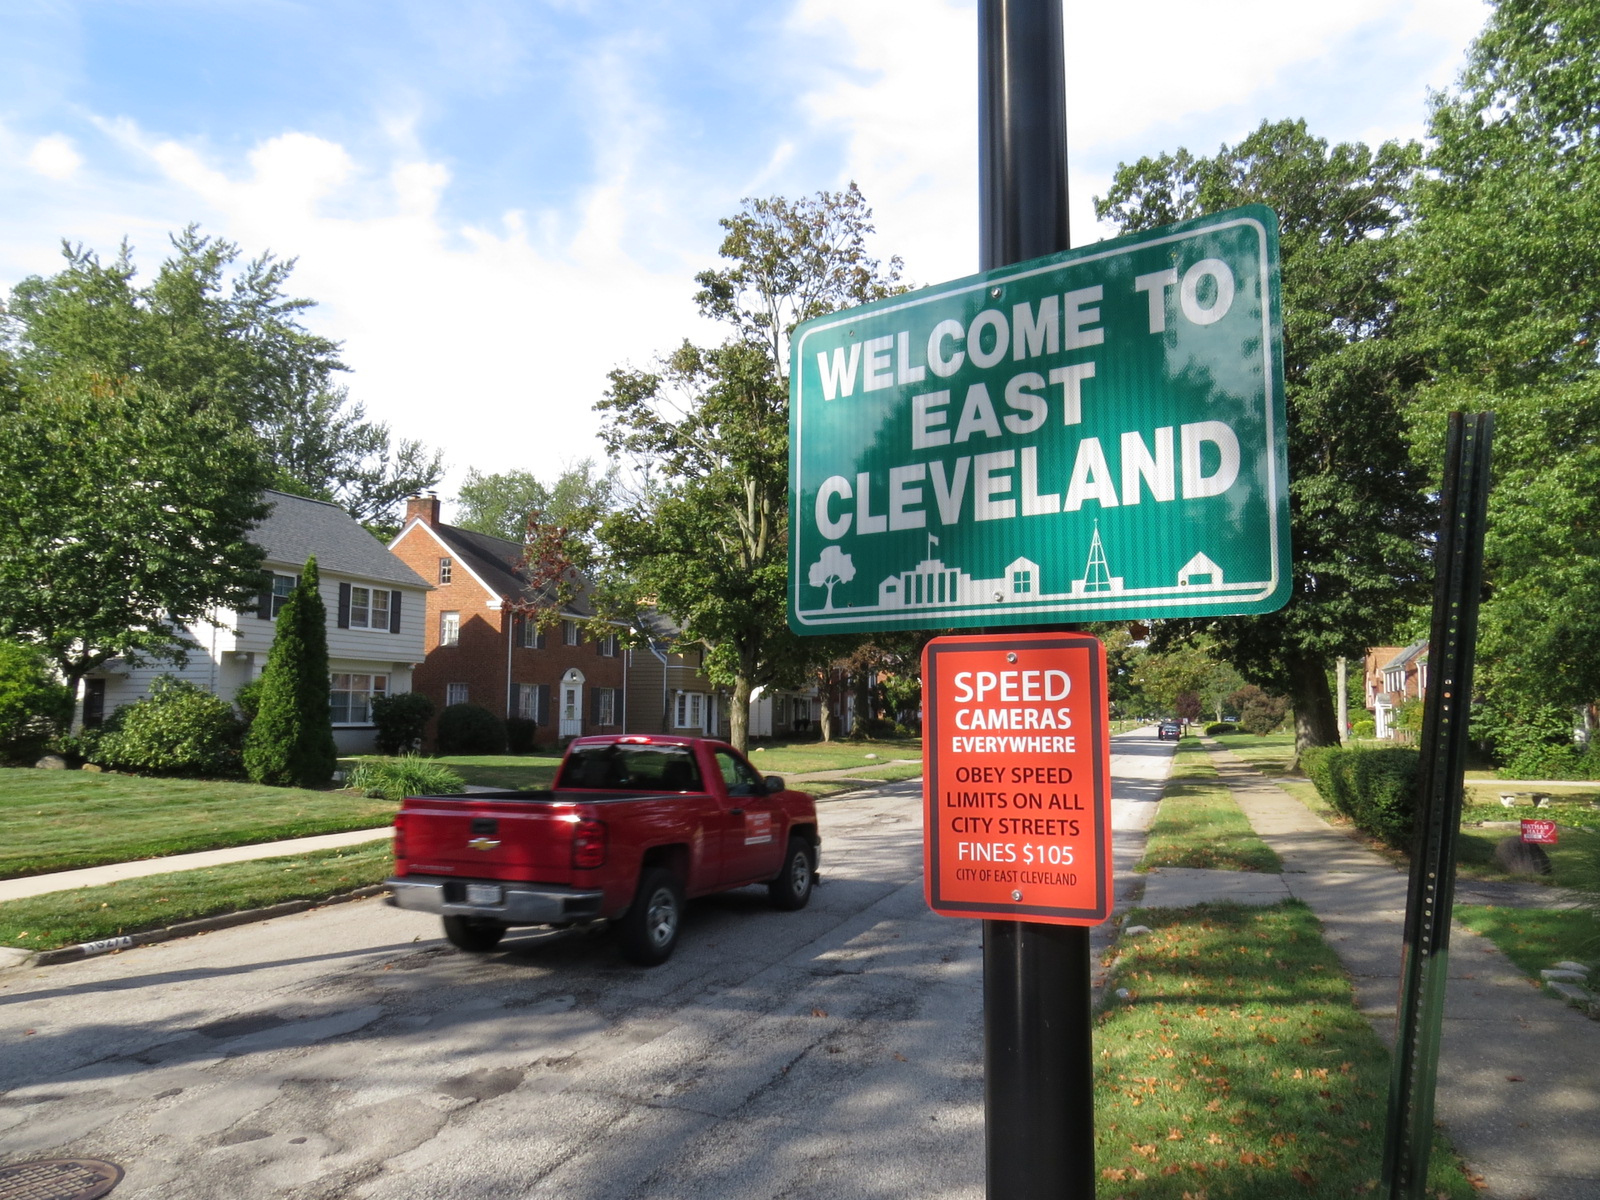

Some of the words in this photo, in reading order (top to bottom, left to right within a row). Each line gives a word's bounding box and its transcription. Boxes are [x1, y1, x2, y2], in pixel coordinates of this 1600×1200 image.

[816, 284, 1104, 401] WELCOME
[1135, 258, 1235, 334] TO
[912, 361, 1095, 450] EAST
[814, 420, 1241, 540] CLEVELAND
[954, 669, 1072, 703] SPEED
[955, 708, 1072, 731] CAMERAS
[952, 736, 1076, 753] EVERYWHERE
[955, 766, 1006, 784] OBEY
[1011, 767, 1073, 784] SPEED
[946, 791, 1007, 809] LIMITS
[1013, 792, 1045, 809] ON
[1048, 793, 1084, 810] ALL
[951, 816, 993, 834] CITY
[998, 818, 1080, 837] STREETS
[958, 842, 1017, 862] FINES
[1022, 842, 1074, 865] $105
[956, 868, 977, 881] CITY
[979, 868, 992, 882] OF
[994, 869, 1019, 883] EAST
[1020, 870, 1077, 886] CLEVELAND
